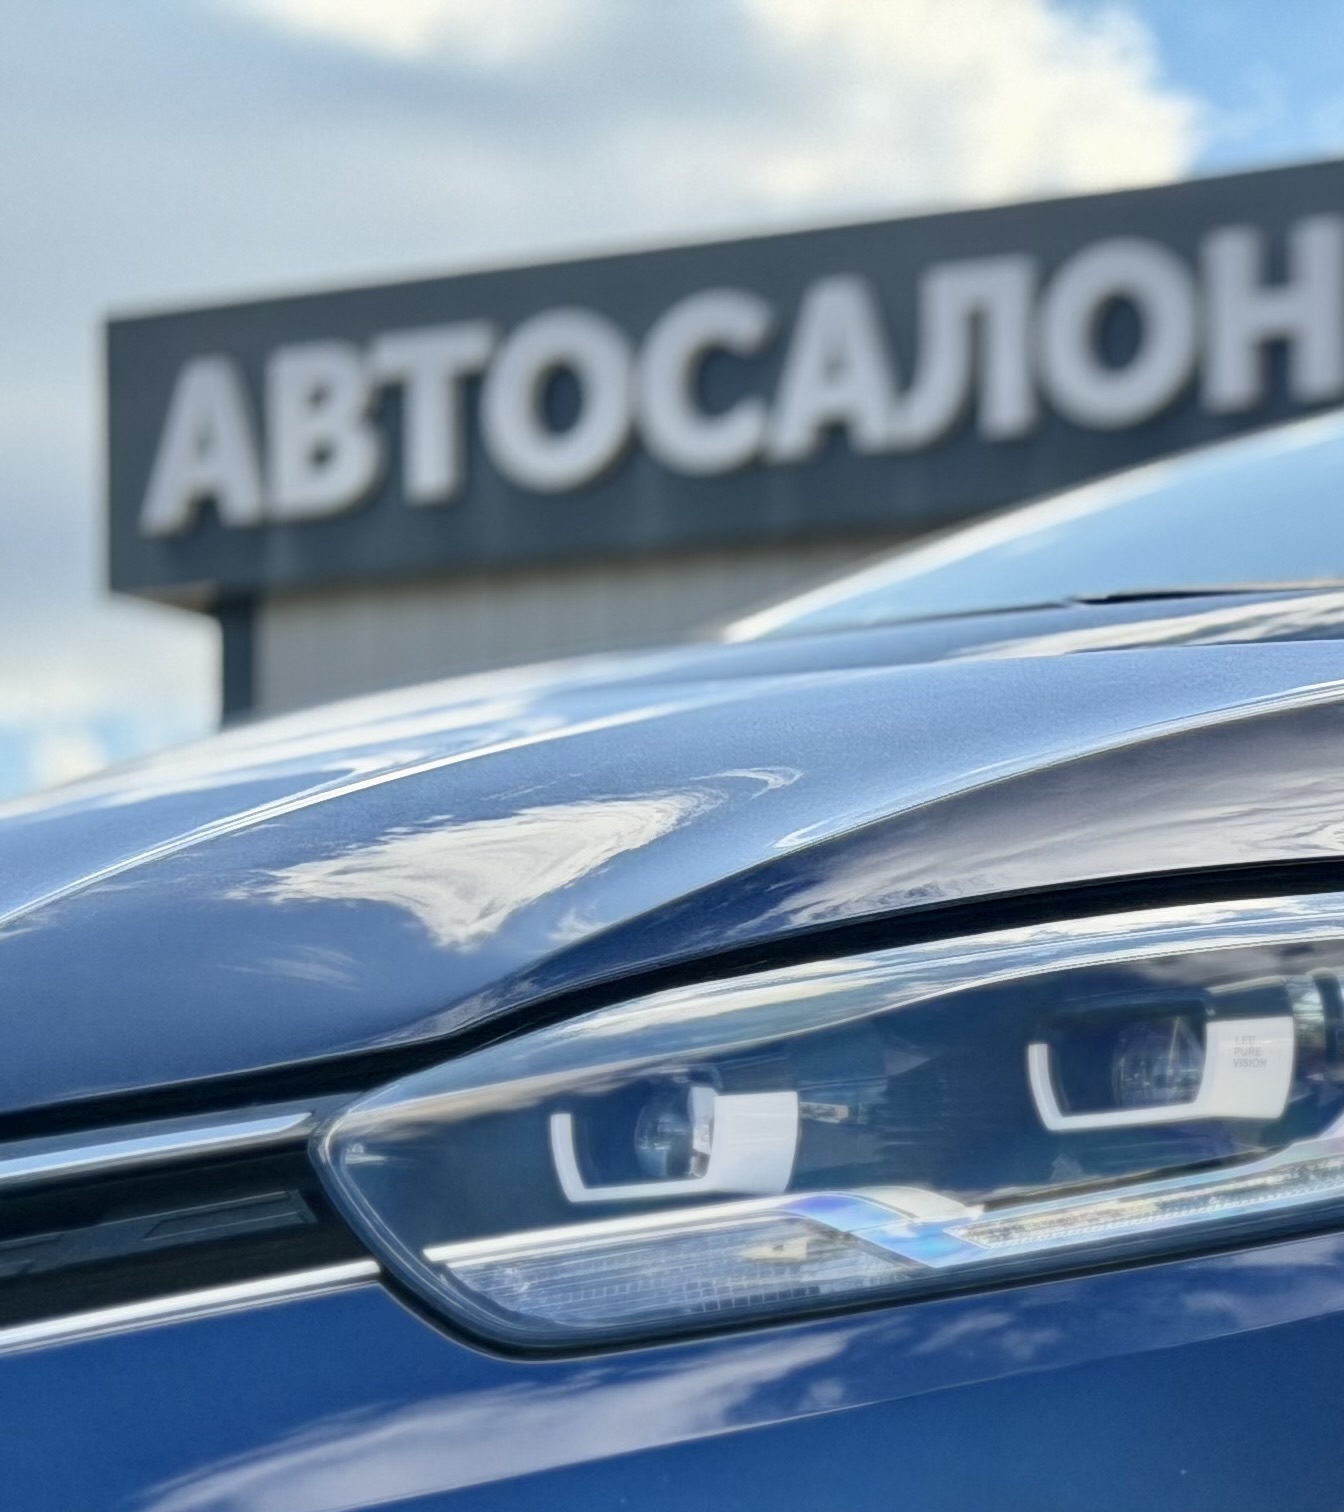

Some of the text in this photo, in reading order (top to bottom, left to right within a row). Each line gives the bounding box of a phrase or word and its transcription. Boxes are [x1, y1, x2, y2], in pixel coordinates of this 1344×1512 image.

[1234, 1034, 1256, 1046] LED
[1233, 1046, 1263, 1057] PURE
[1232, 1057, 1268, 1069] VISION
